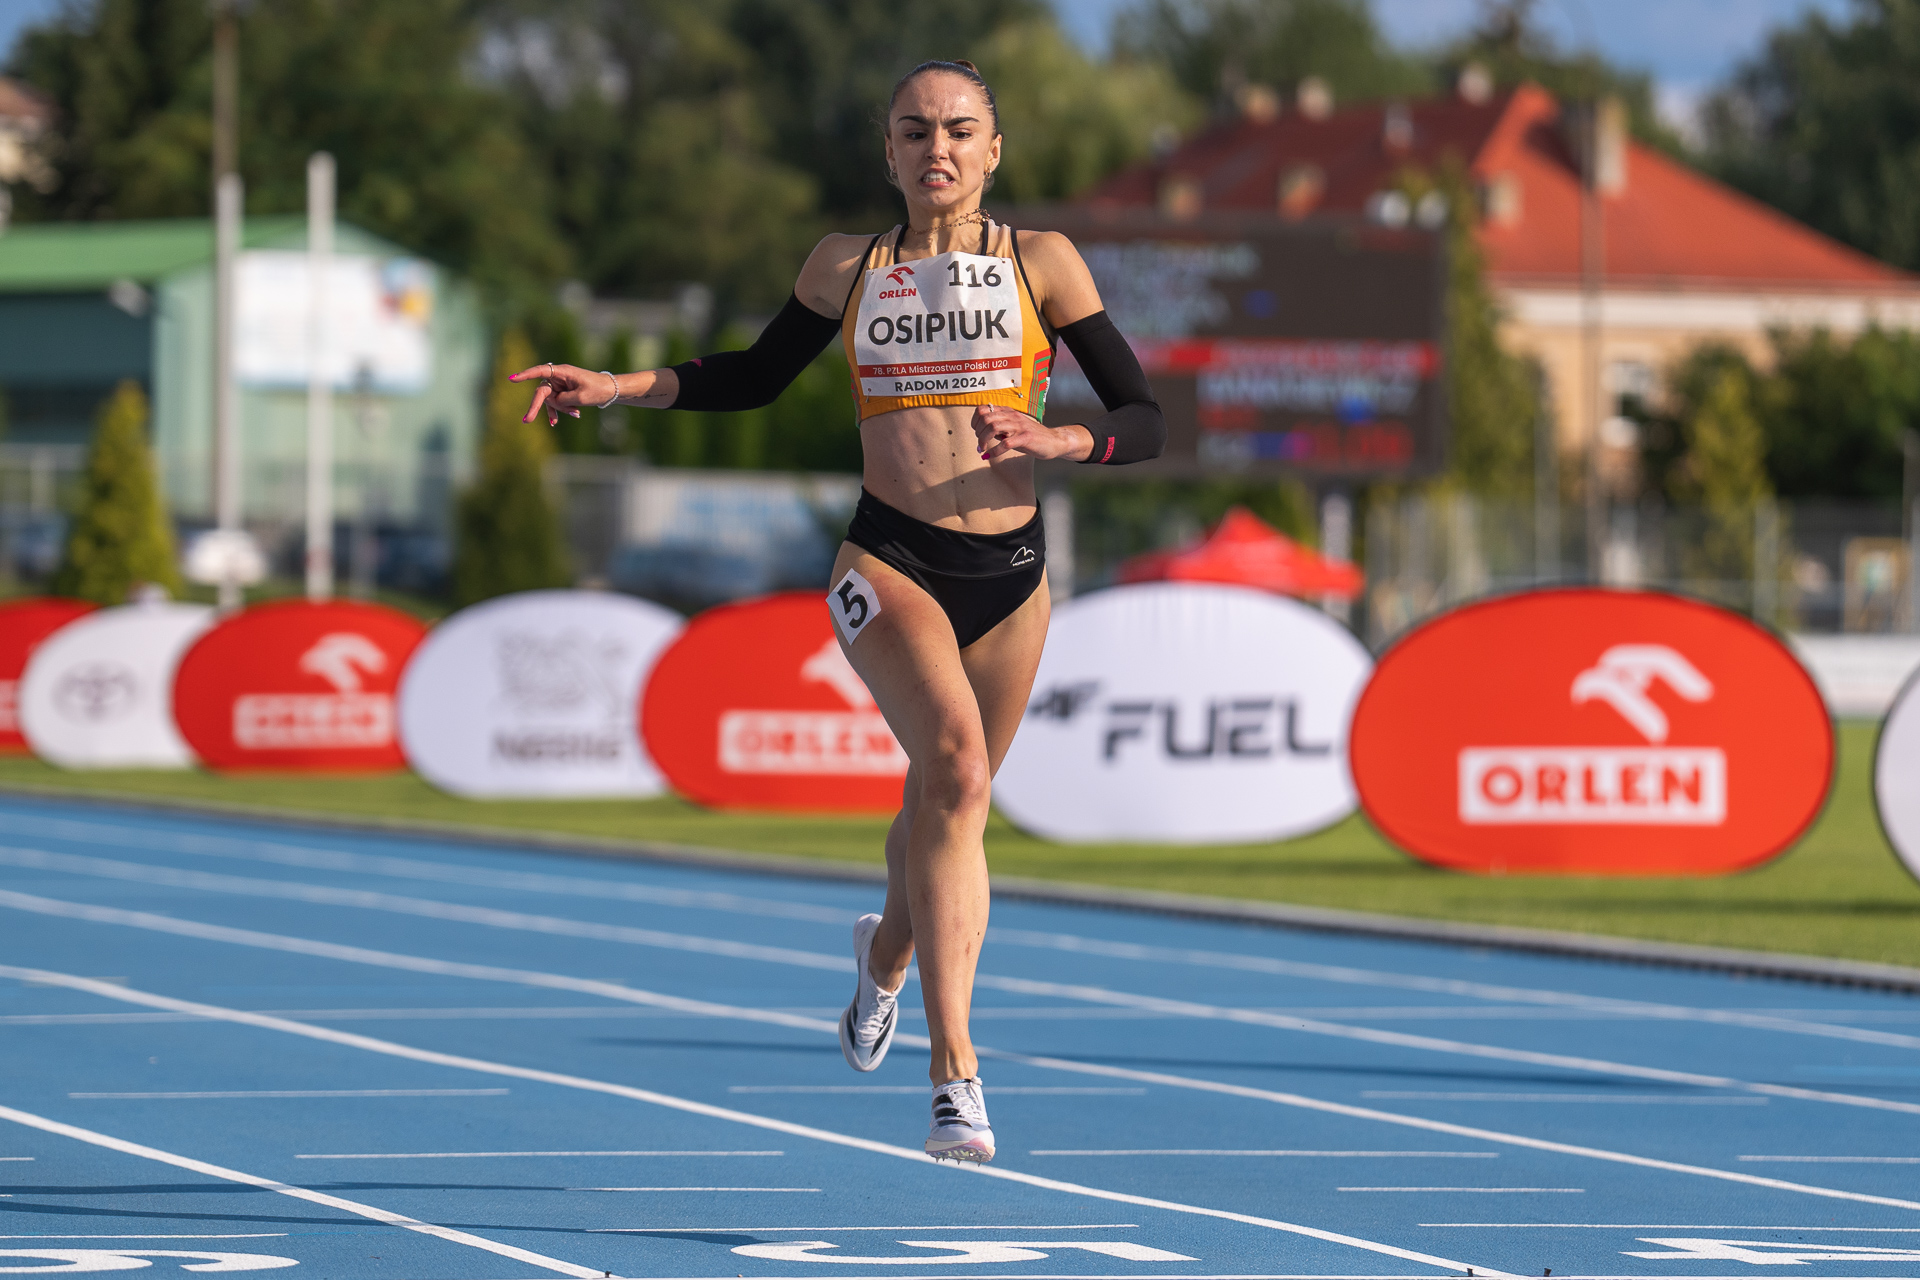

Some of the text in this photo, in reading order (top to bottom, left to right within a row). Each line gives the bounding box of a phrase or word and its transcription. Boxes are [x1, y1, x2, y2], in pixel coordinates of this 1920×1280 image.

[947, 261, 1002, 287] 116
[879, 288, 917, 299] ORLEN
[868, 309, 1010, 345] OSIPIUK
[873, 359, 1008, 375] 78. PZLA Mistrzostwa Polski U20
[895, 376, 986, 392] RADOM 2024
[837, 580, 868, 629] 5
[1104, 697, 1333, 762] FUEL
[1480, 763, 1702, 806] ORLEN
[730, 1240, 1201, 1265] 5
